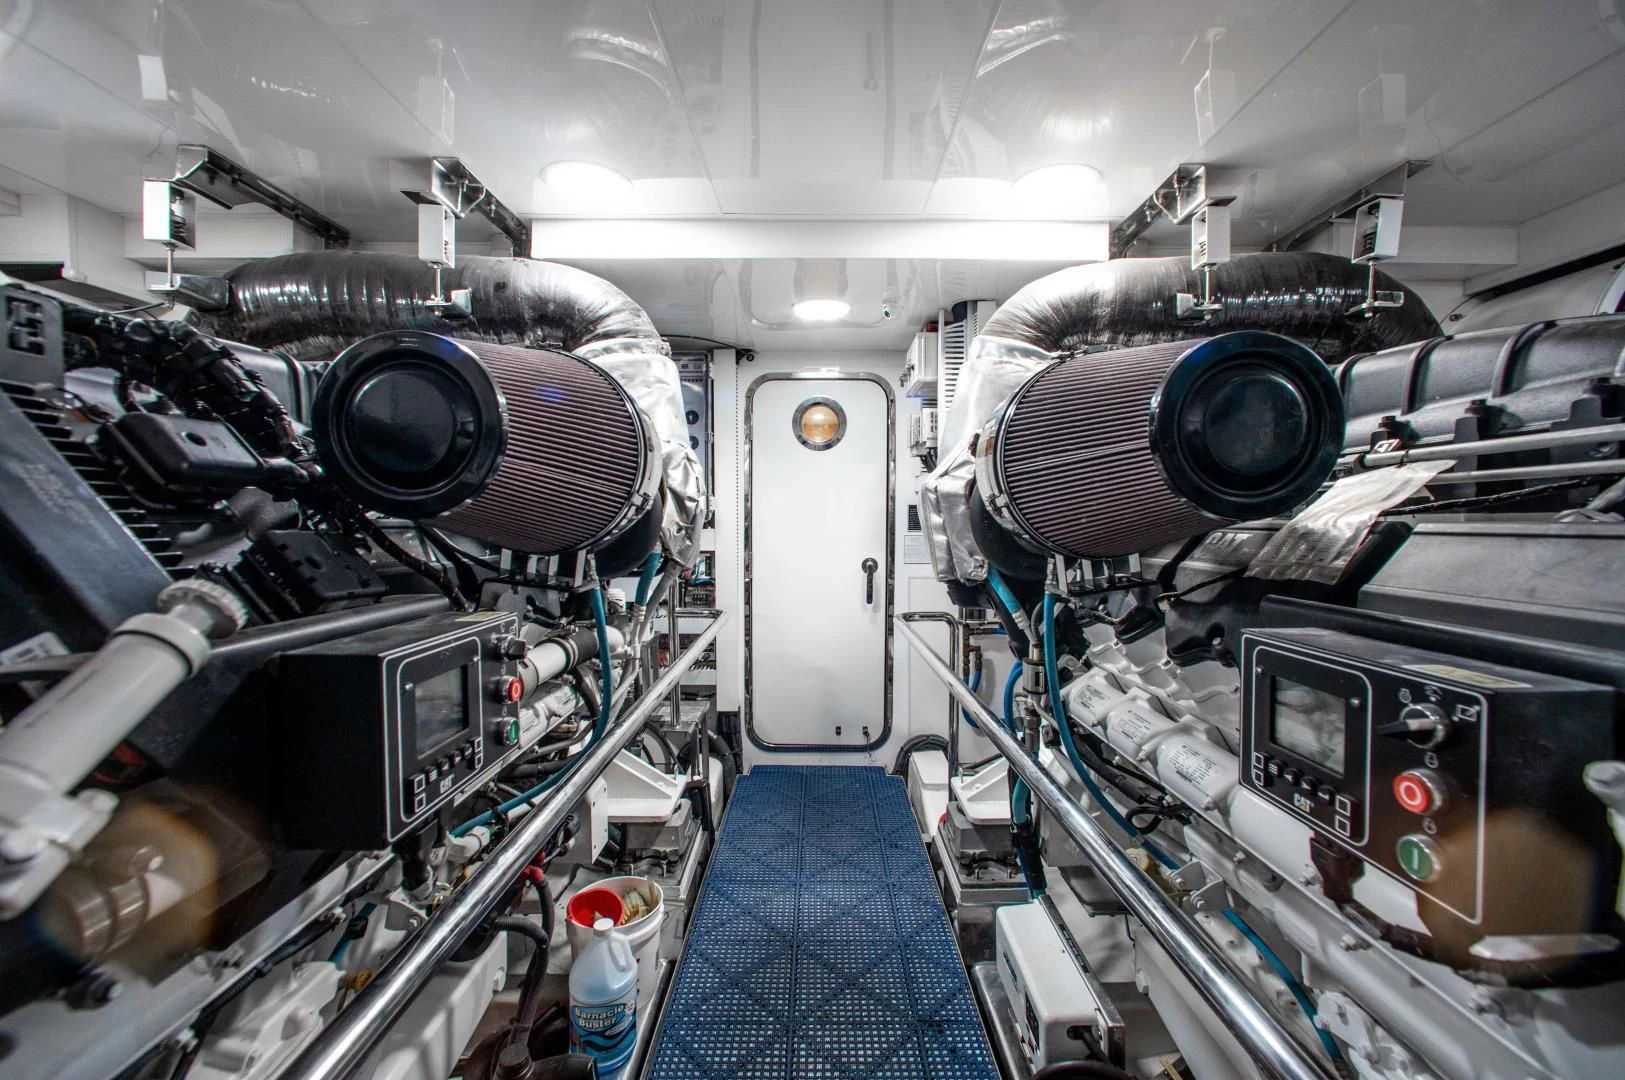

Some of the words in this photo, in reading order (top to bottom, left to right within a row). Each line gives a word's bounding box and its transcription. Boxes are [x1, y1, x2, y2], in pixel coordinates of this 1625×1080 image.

[440, 774, 454, 793] CAT
[1294, 792, 1312, 813] CAT
[575, 1005, 624, 1020] Barnacle
[579, 1017, 617, 1029] Buster
